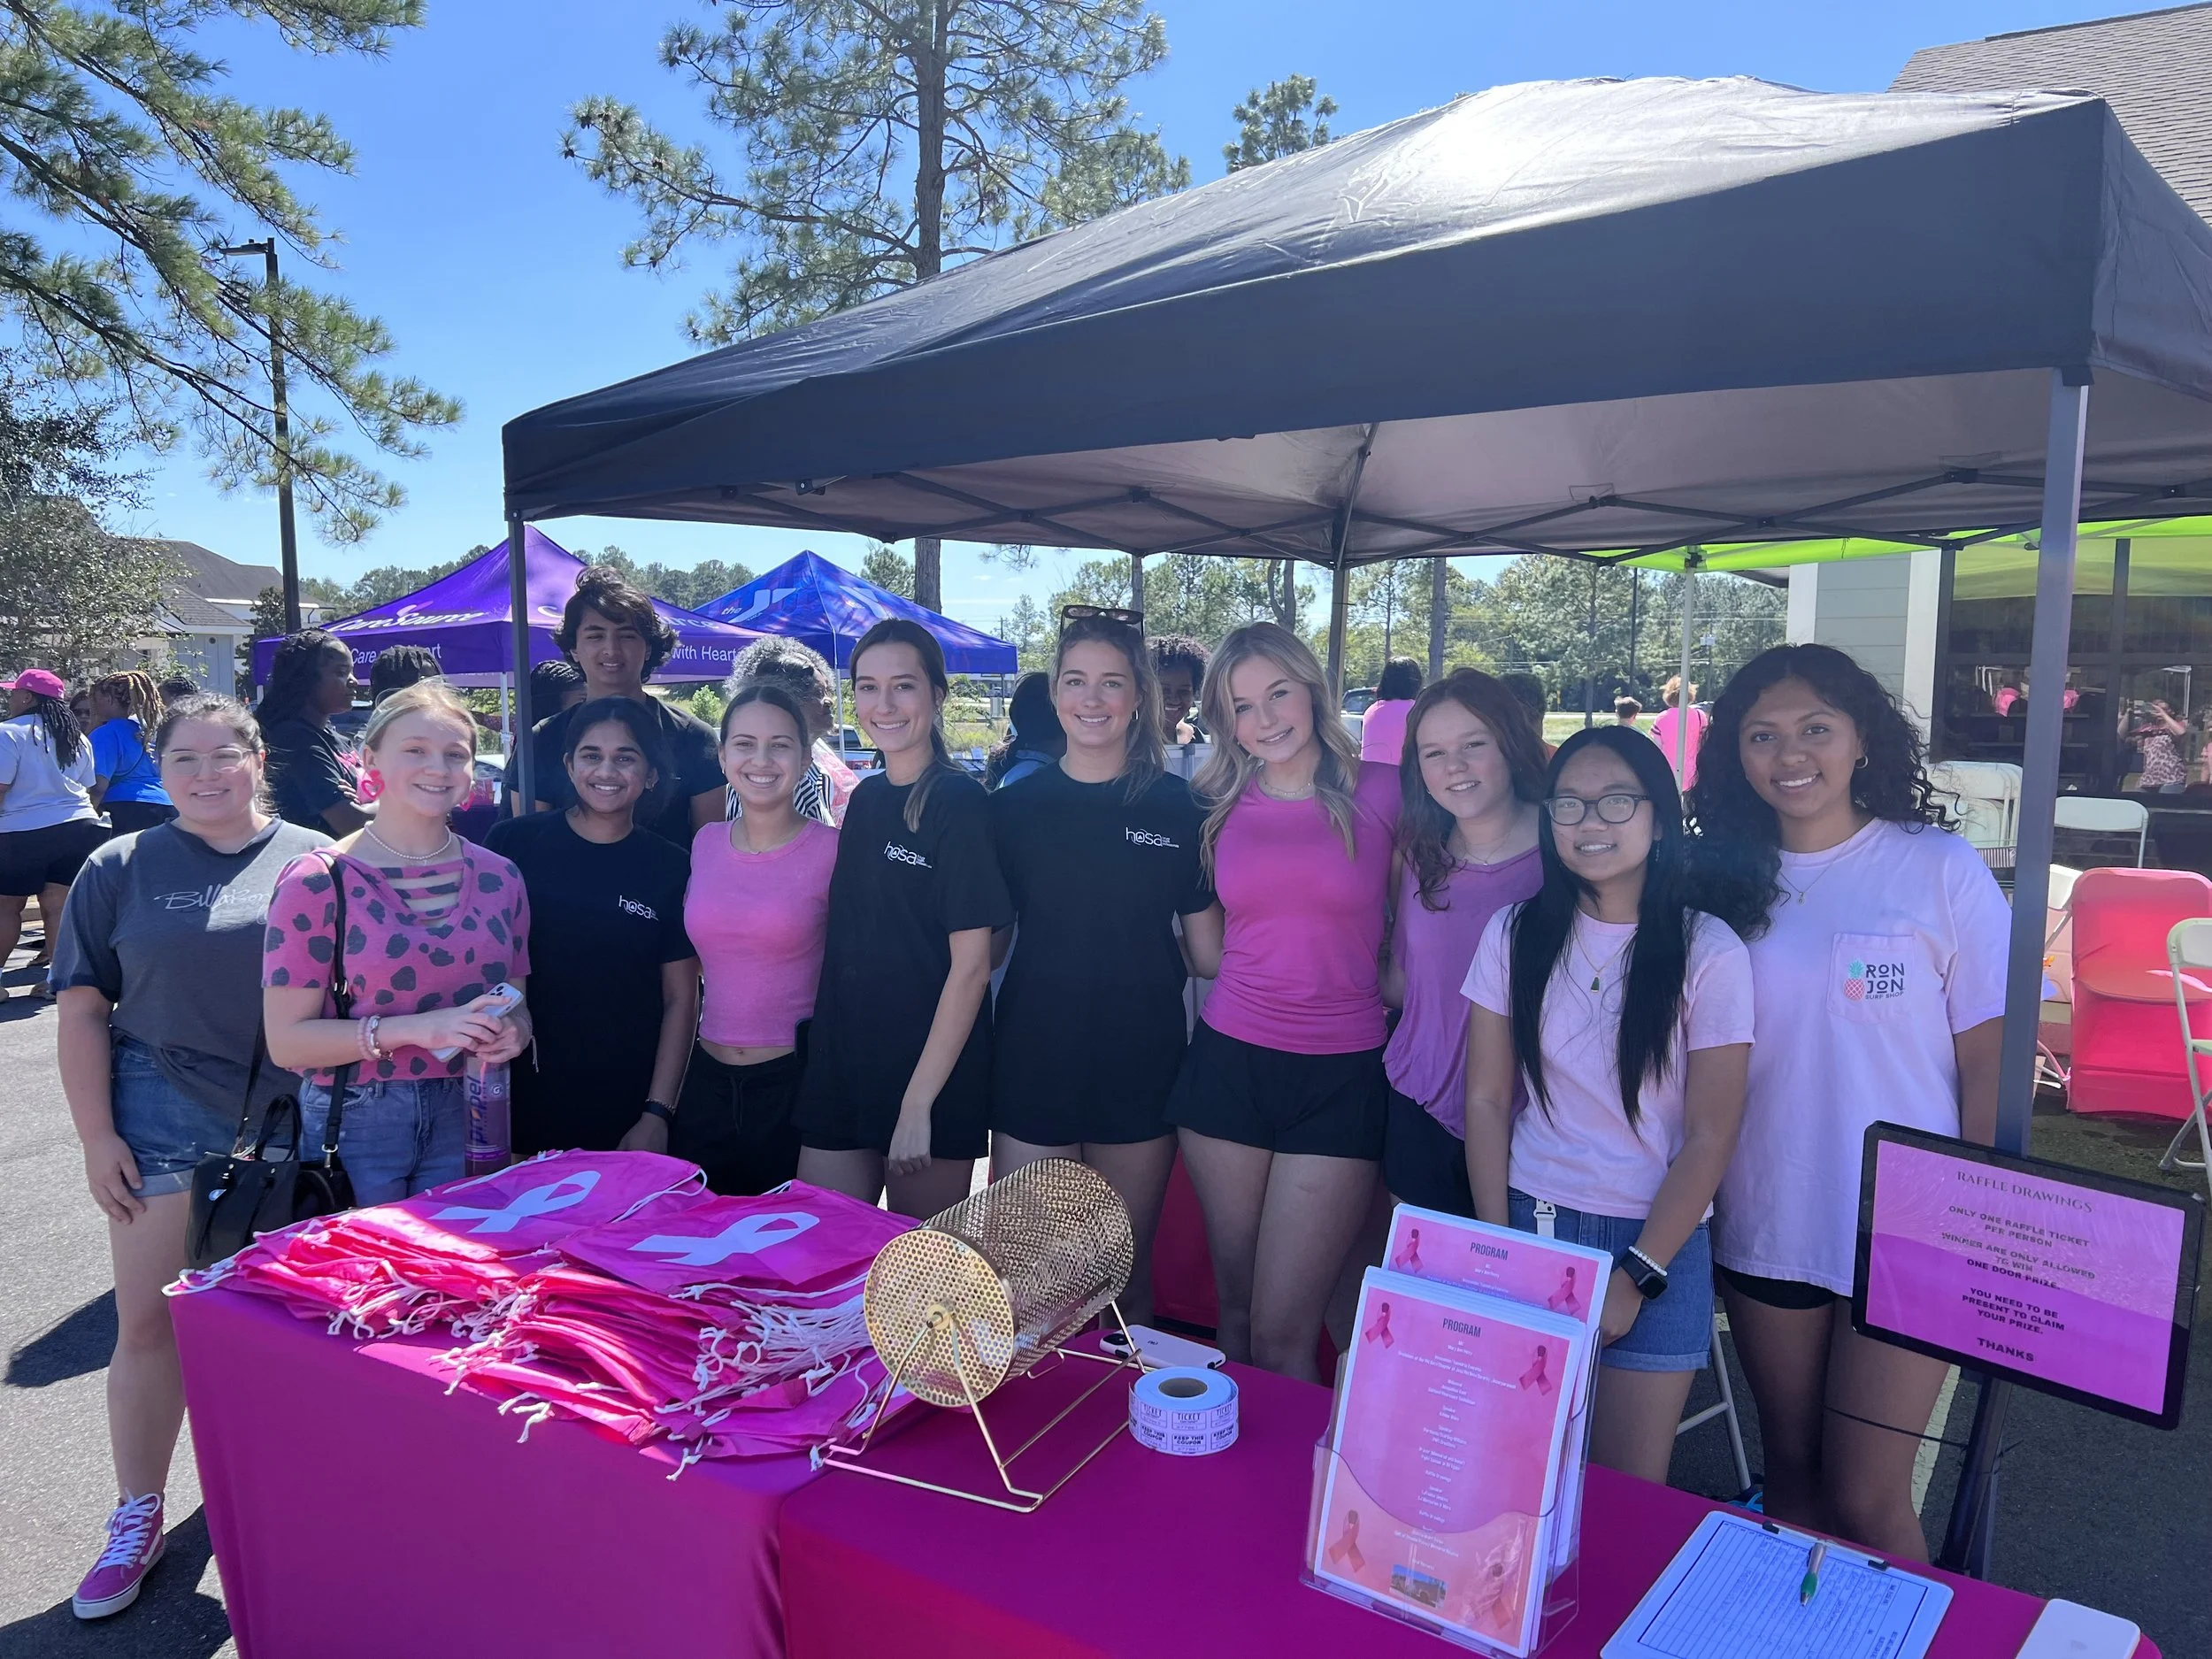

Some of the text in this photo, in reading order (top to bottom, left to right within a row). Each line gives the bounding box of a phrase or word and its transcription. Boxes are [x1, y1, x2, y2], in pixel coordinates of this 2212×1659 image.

[351, 649, 376, 664] Care
[702, 645, 736, 662] Heart
[1125, 826, 1163, 847] hosa
[884, 841, 917, 865] hosa
[618, 895, 651, 919] hosa
[1865, 963, 1905, 978] RON
[1866, 978, 1903, 994] JON
[1957, 1171, 2093, 1213] RAFFLE DRAWINGS
[1948, 1205, 2091, 1247] ONLY ONE RAFFLE TICKET
[1985, 1224, 2053, 1248] PER PERSON
[1470, 1241, 1509, 1261] PROGRAM
[1985, 1244, 2007, 1256] ARE
[2009, 1251, 2039, 1263] ONLY
[2042, 1260, 2096, 1279] ALLOWED
[1967, 1258, 2061, 1290] ONE DOOR PRIZE.
[1962, 1294, 2065, 1331] PRESENT TO CLAIM
[1970, 1287, 2059, 1319] YOU NEED TO BE
[1442, 1317, 1482, 1338] PROGRAM
[1977, 1309, 2044, 1334] YOUR PRIZE.
[1977, 1337, 2035, 1363] THANKS
[1178, 1412, 1201, 1421] TICKET
